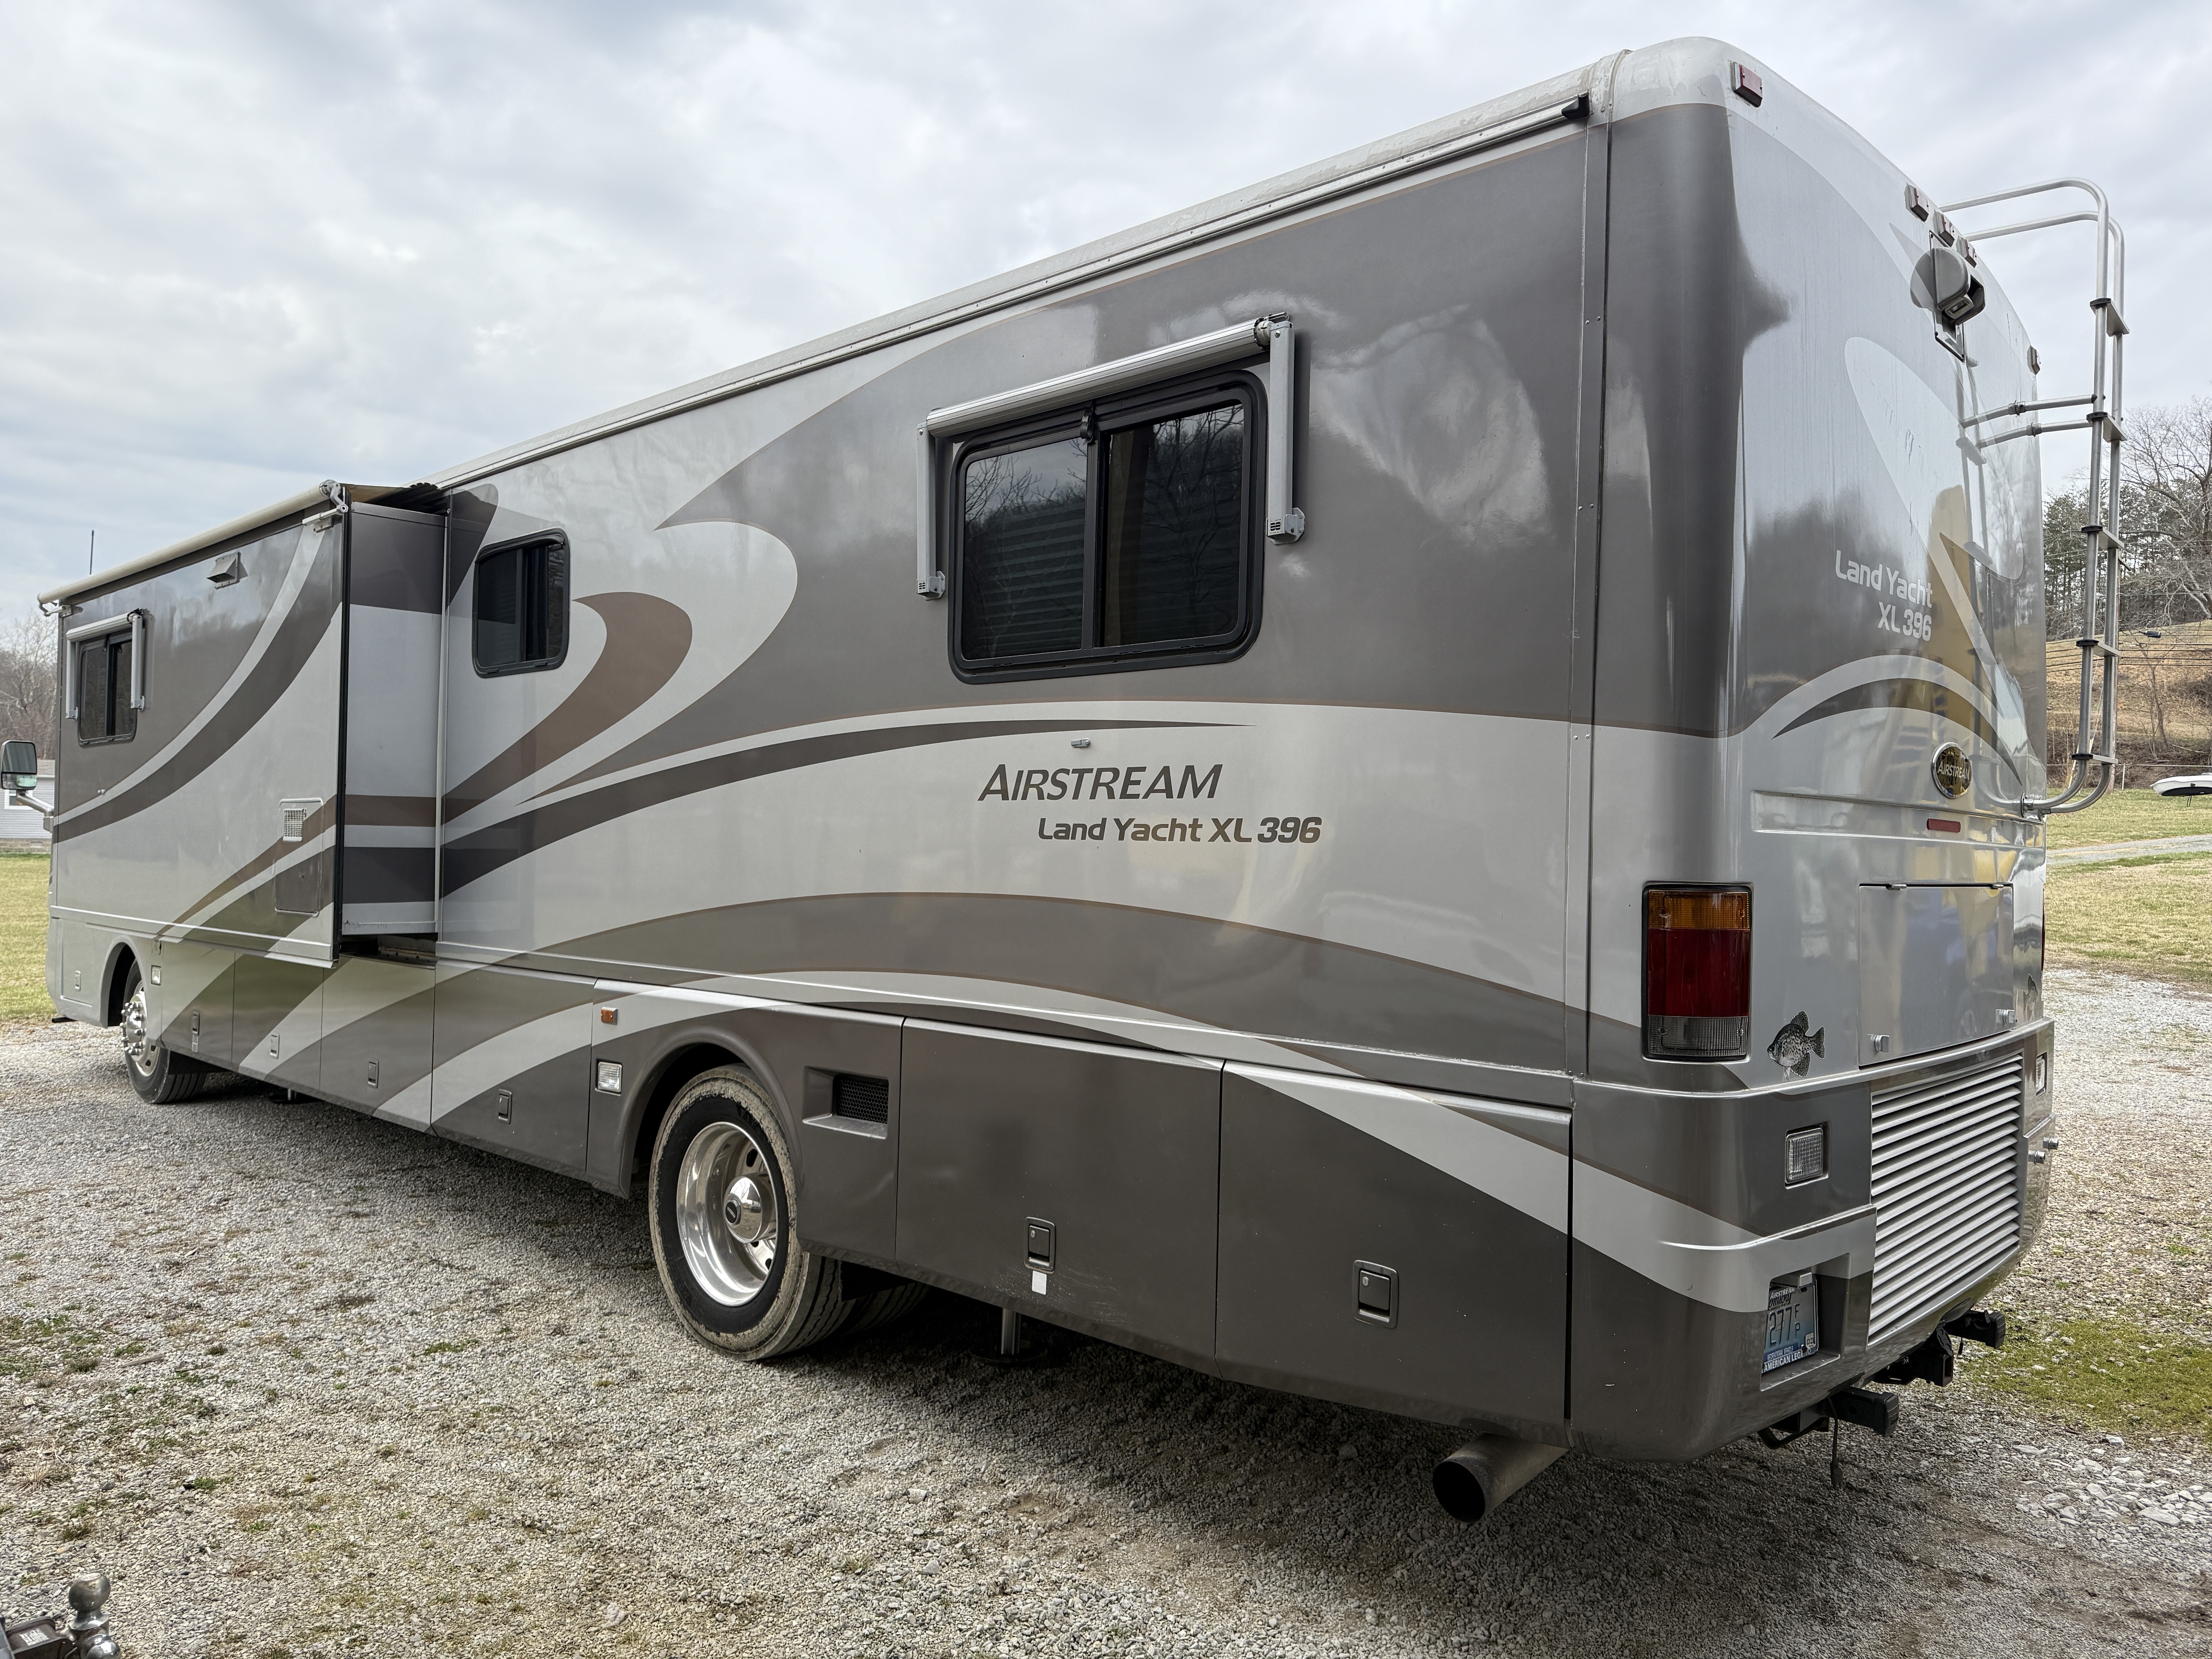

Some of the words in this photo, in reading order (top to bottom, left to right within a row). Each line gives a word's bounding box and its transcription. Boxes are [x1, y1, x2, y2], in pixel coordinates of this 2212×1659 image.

[1835, 550, 1882, 591] Land
[1886, 566, 1933, 608] Yacht
[1877, 601, 1901, 633] XL
[1903, 609, 1932, 641] 396
[1038, 817, 1107, 840] Land
[1113, 818, 1202, 842] Yacht
[1207, 818, 1252, 843] XL
[1257, 816, 1322, 843] 396
[1764, 1307, 1792, 1348] 277
[1764, 1355, 1791, 1372] AMERICAN
